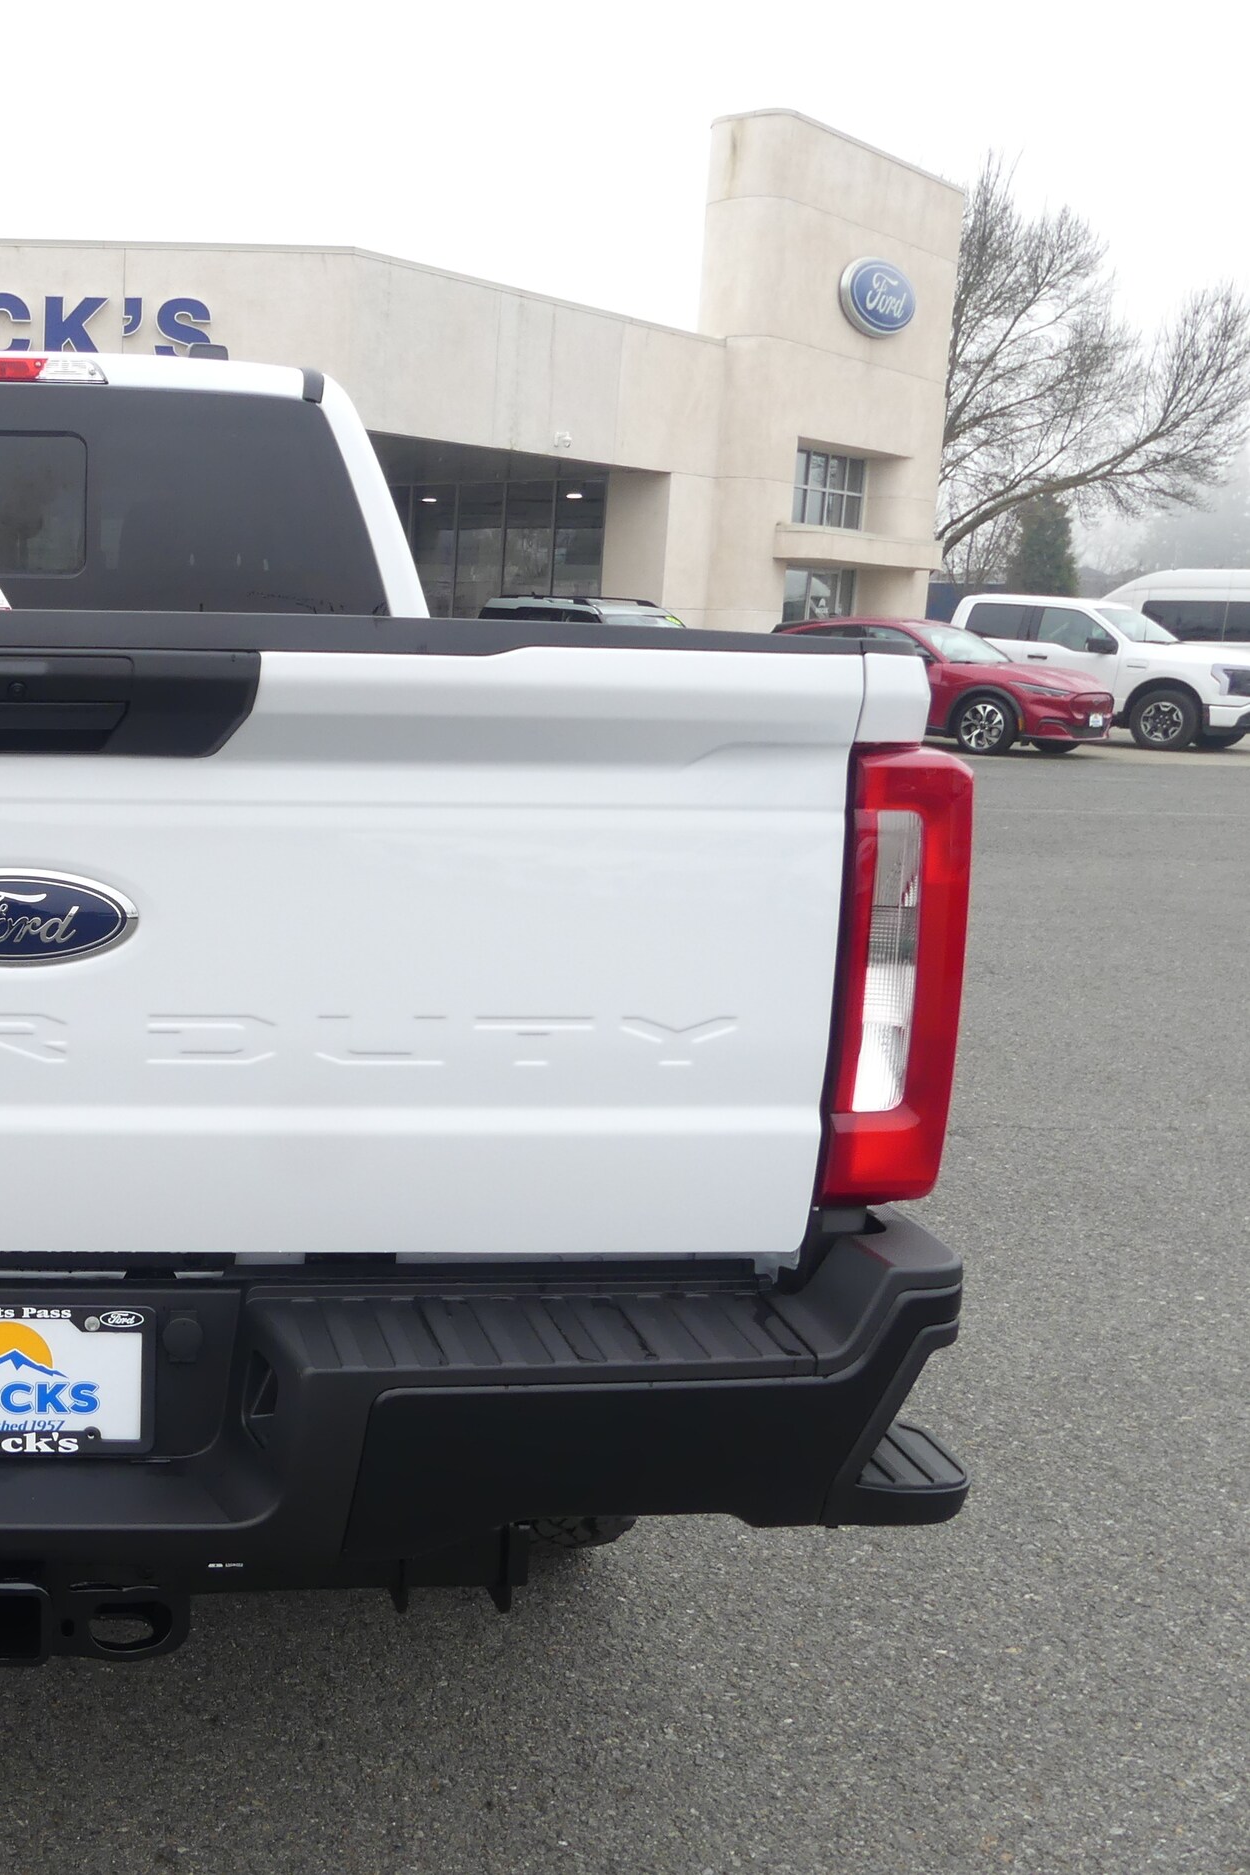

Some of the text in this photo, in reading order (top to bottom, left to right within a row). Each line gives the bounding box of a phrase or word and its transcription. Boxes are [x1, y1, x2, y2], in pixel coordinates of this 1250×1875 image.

[865, 271, 907, 319] Ford
[146, 1013, 739, 1066] DUTY
[21, 1306, 73, 1320] Pass
[107, 1313, 136, 1325] Ford
[31, 1419, 66, 1432] 1957
